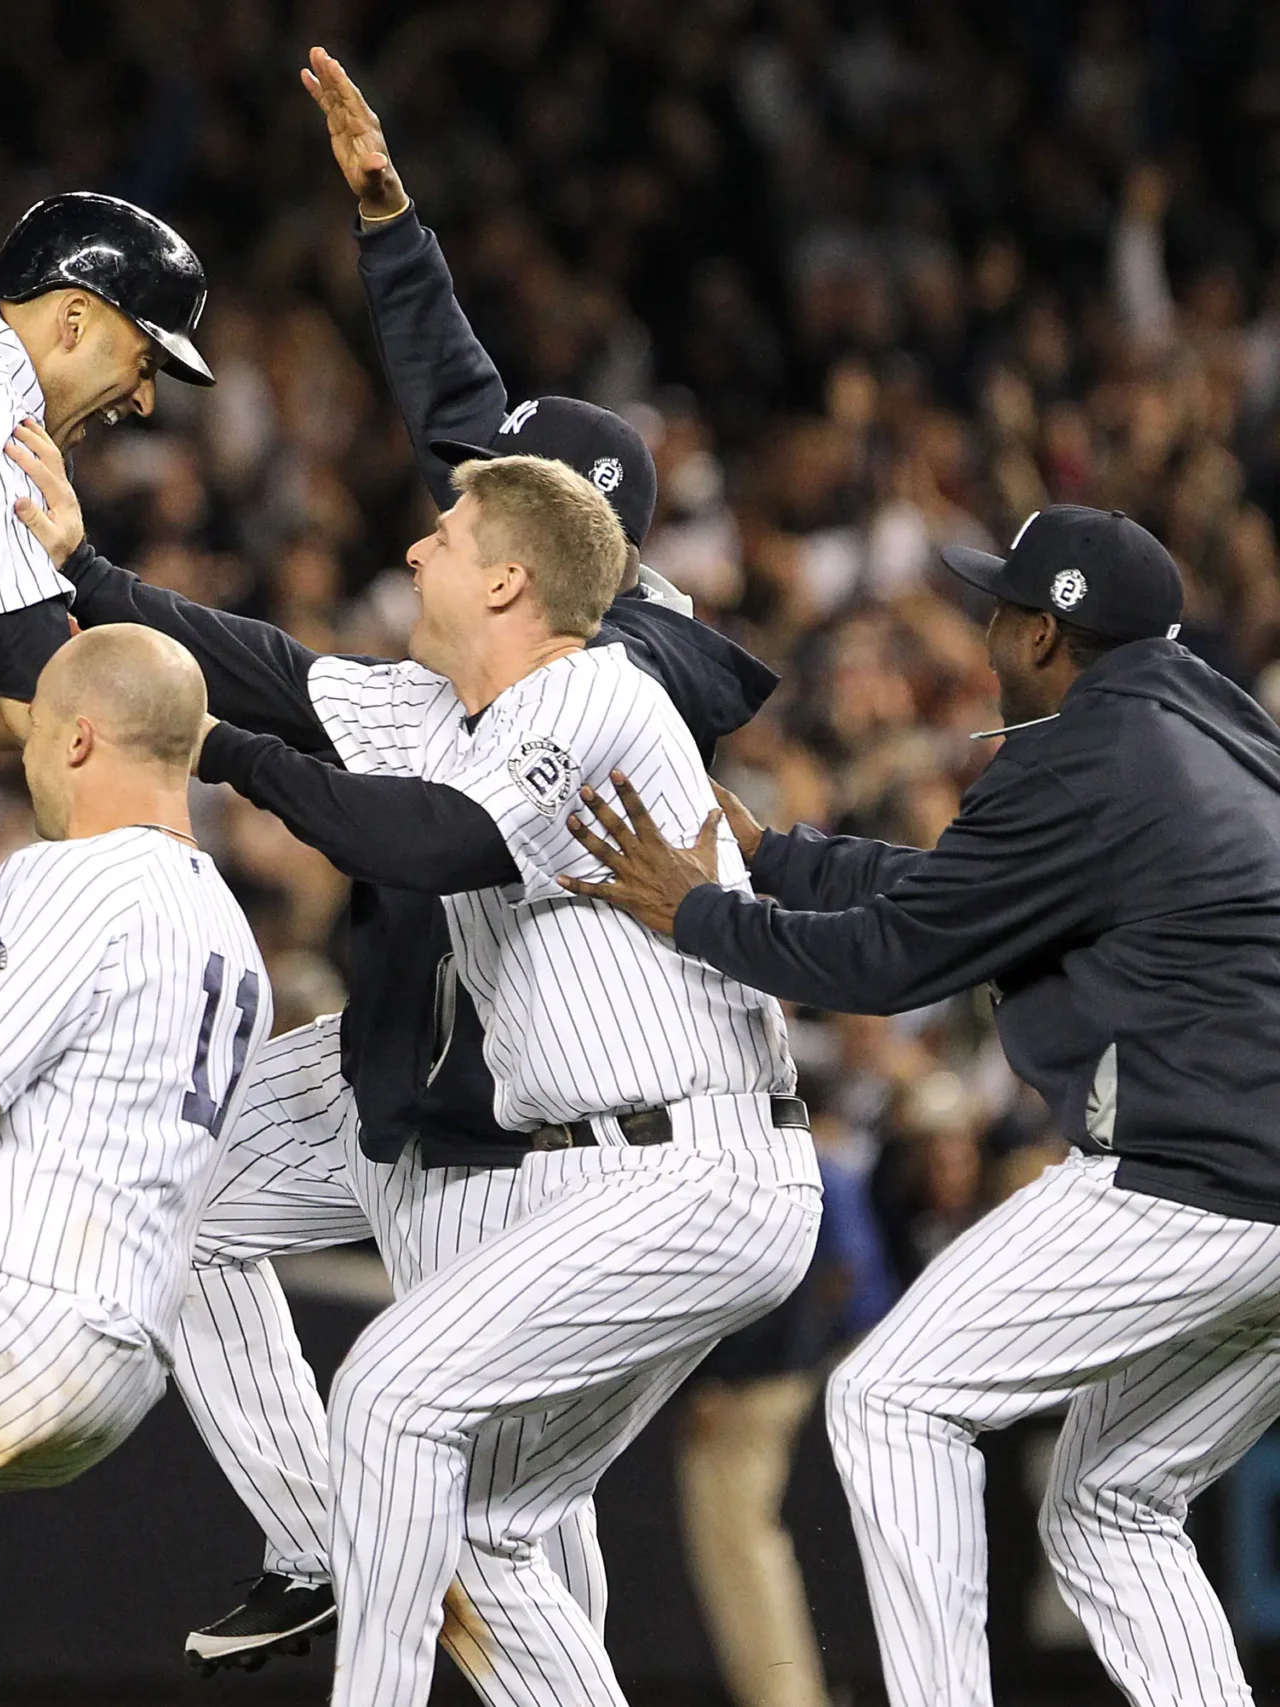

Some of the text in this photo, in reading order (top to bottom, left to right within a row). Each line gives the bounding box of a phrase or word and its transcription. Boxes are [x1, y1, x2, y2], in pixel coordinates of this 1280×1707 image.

[598, 466, 615, 489] 2
[1060, 579, 1076, 602] 2
[526, 757, 559, 796] 2
[181, 951, 258, 1140] 11
